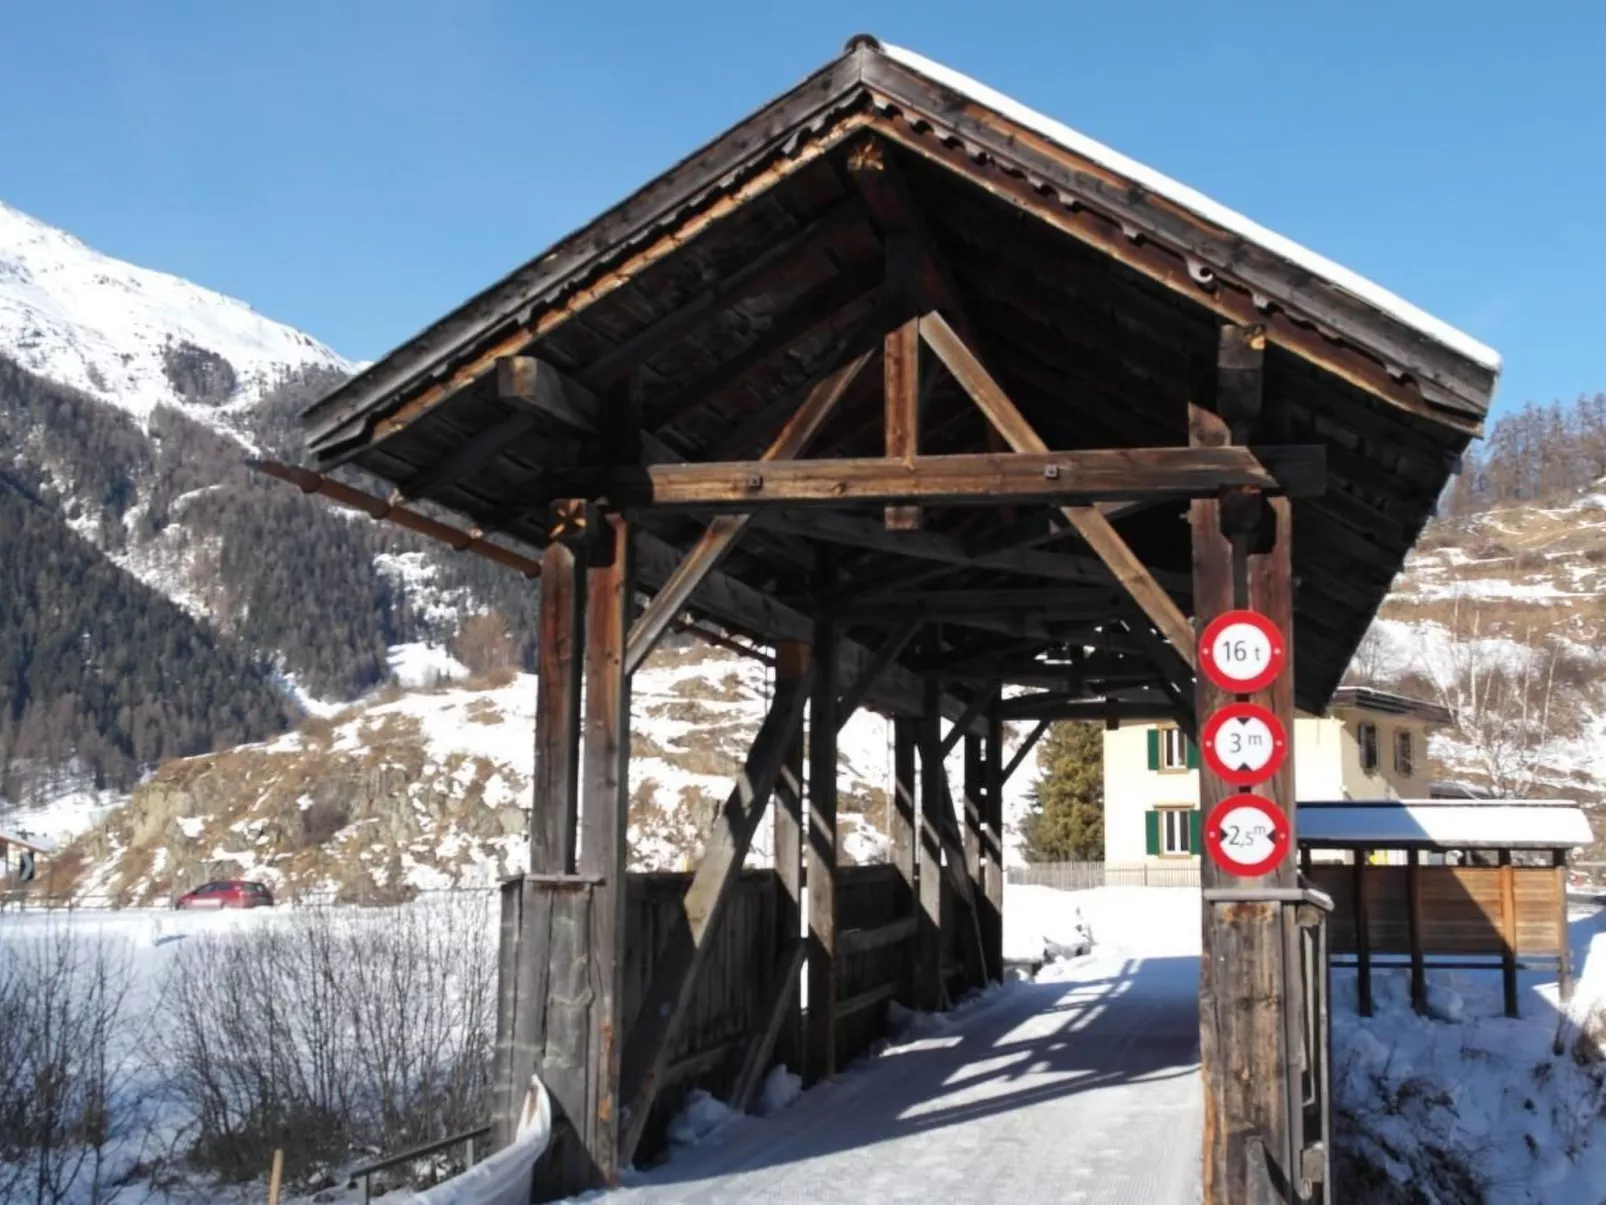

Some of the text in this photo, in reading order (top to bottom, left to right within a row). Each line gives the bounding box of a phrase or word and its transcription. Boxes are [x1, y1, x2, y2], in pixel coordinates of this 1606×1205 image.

[1223, 640, 1262, 662] 16 t
[1229, 732, 1263, 754] 3 m
